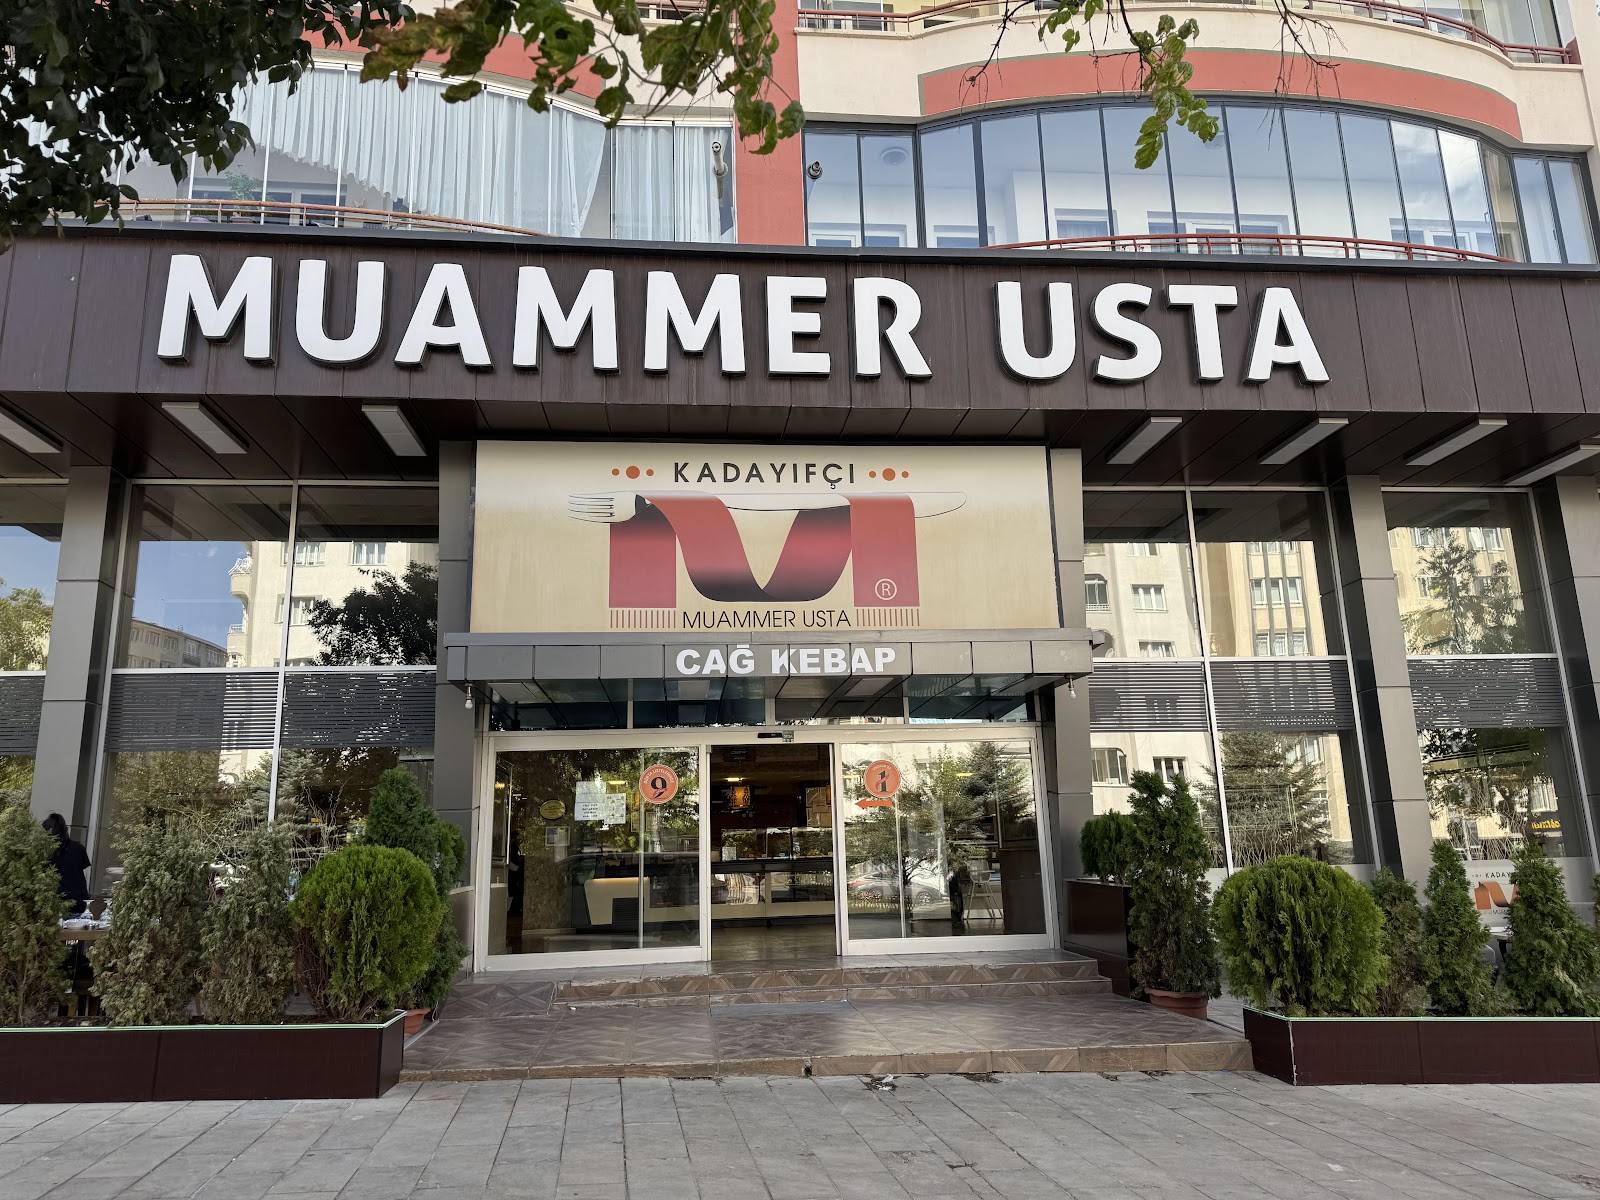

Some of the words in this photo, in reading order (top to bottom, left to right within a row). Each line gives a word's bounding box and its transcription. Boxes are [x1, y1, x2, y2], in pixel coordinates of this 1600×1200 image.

[157, 253, 932, 379] MUAMMER
[996, 280, 1331, 384] USTA
[674, 462, 855, 490] KADAYIFÇI
[682, 610, 796, 629] MUAMMER
[802, 609, 851, 628] USTA
[675, 643, 756, 675] CAĞ
[770, 646, 897, 674] KEBAP
[1484, 871, 1512, 879] KADAY
